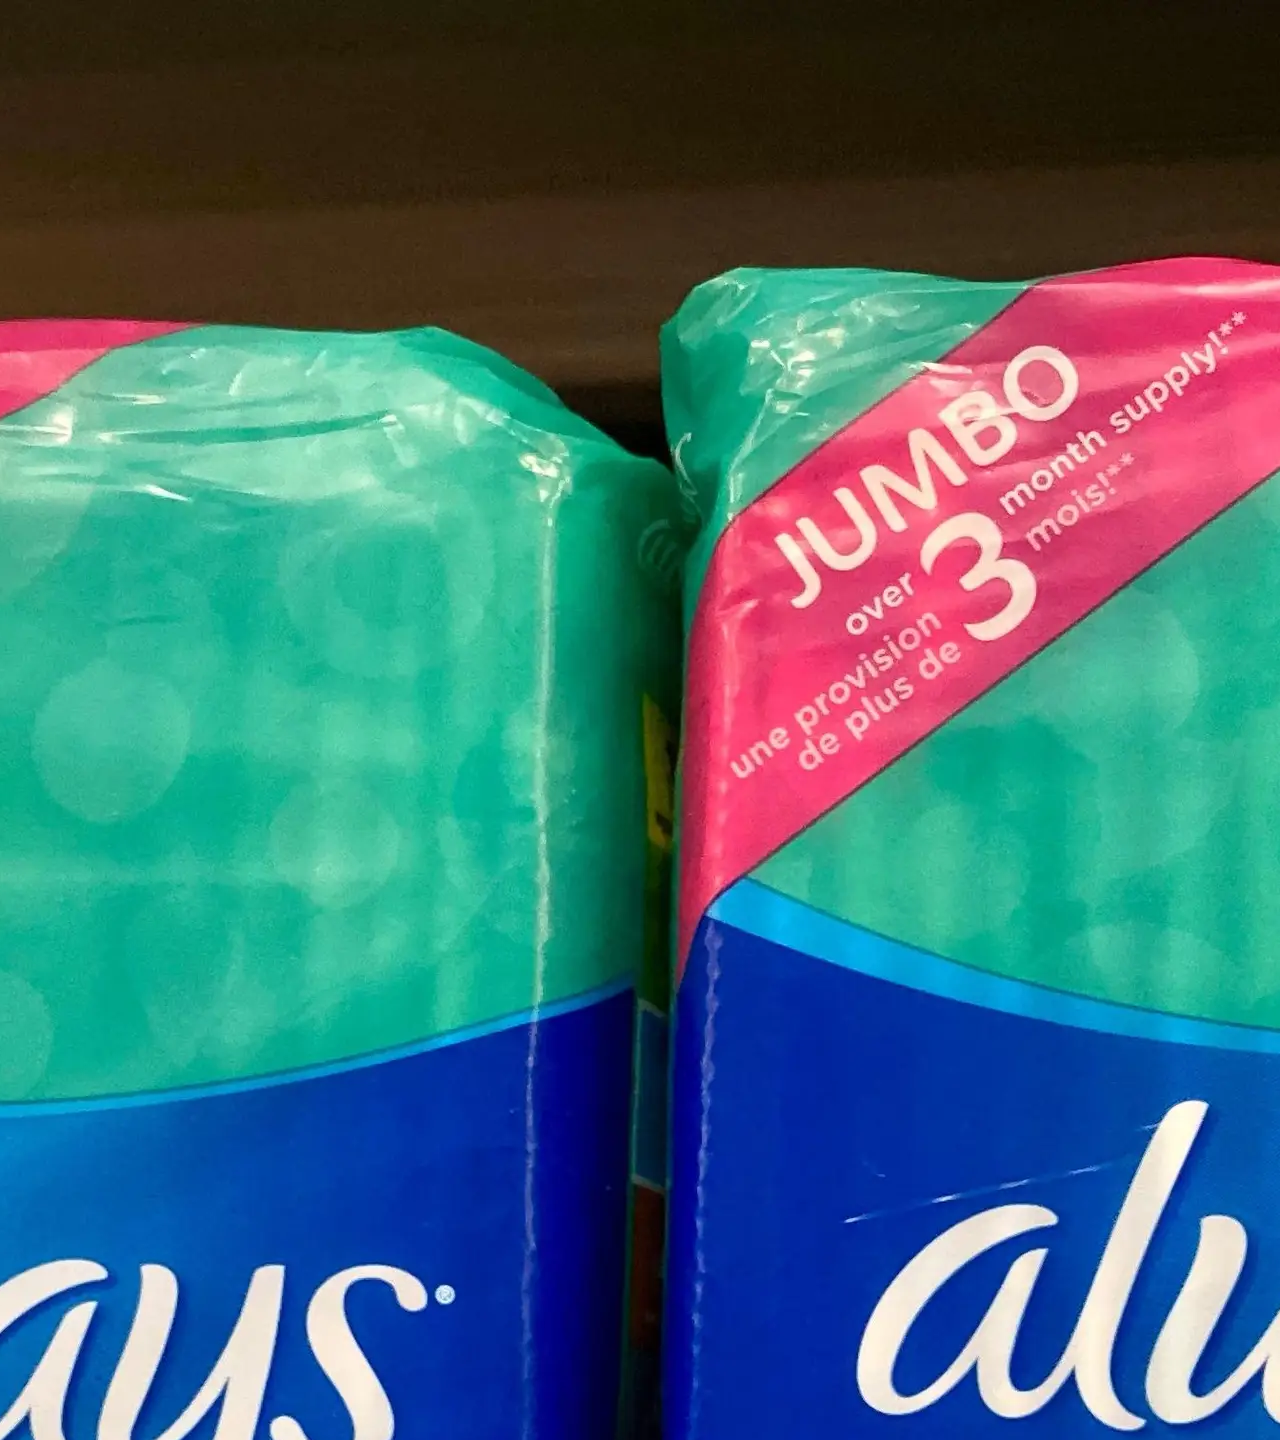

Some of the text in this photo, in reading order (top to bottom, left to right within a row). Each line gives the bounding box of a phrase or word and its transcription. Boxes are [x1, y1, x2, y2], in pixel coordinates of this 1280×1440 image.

[773, 345, 1079, 610] JUMBO
[846, 572, 914, 635] over
[920, 511, 1037, 641] 3
[999, 430, 1106, 518] month
[730, 611, 941, 779] une provision
[799, 641, 961, 770] de plus de
